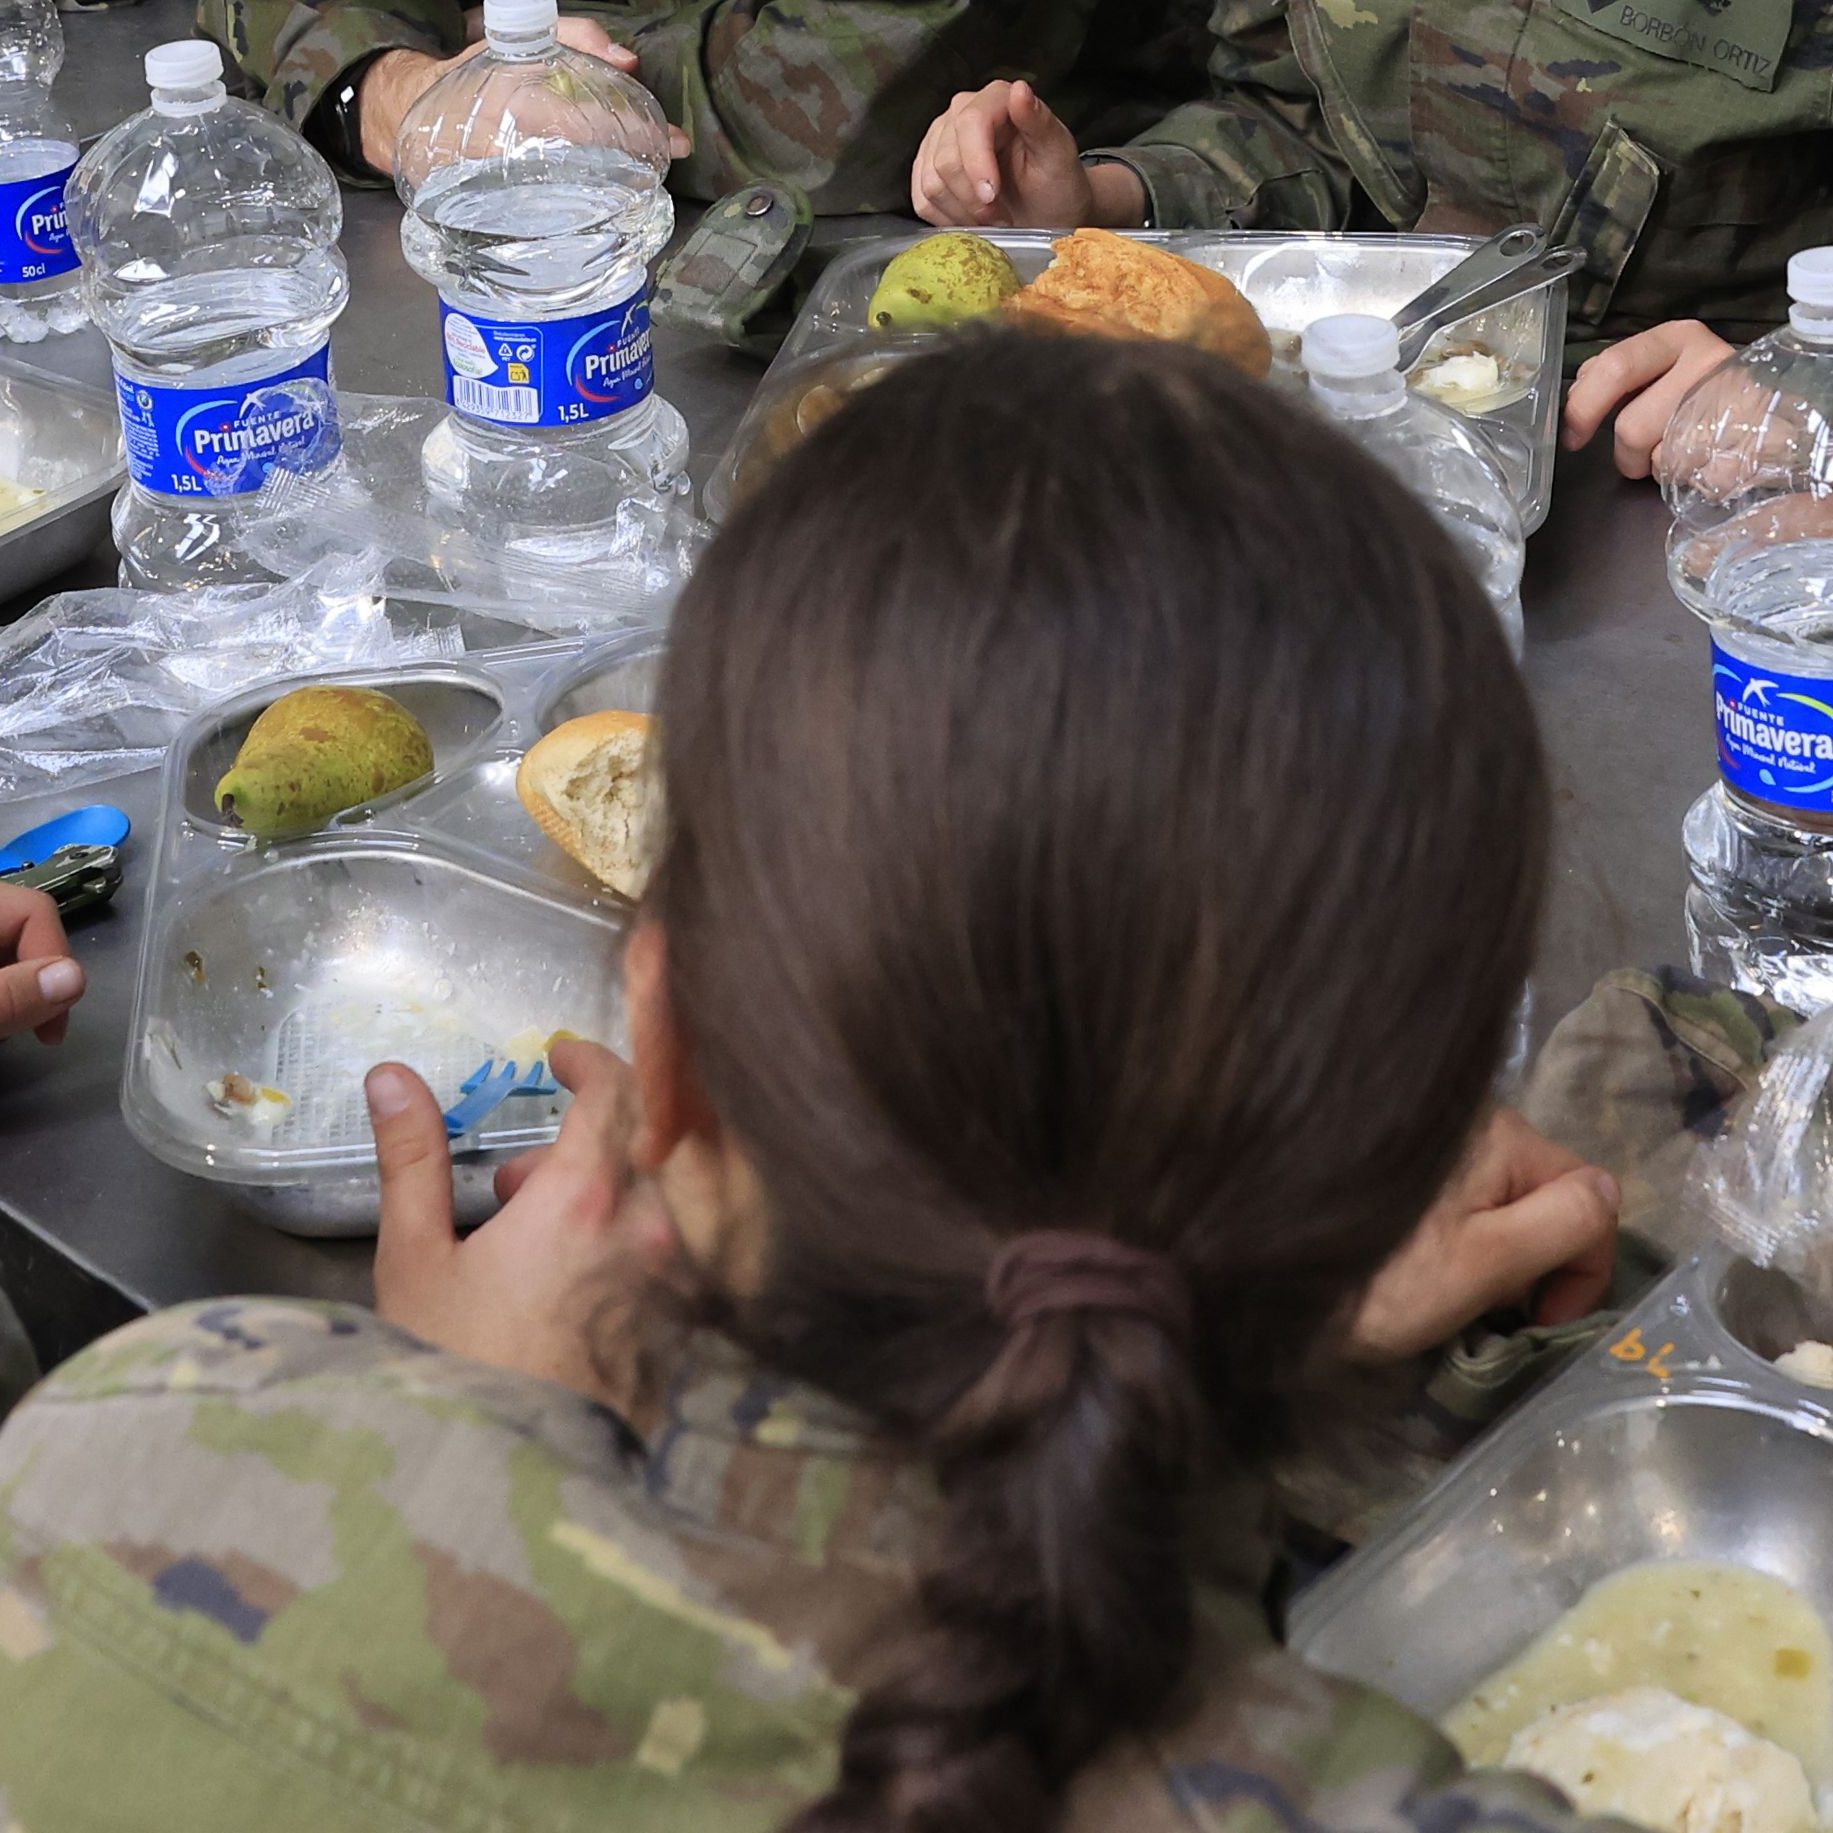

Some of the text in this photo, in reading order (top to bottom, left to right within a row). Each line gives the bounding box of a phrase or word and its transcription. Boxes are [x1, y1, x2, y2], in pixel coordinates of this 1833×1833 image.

[1713, 39, 1772, 73] ORTIZ
[234, 410, 281, 428] FUENTE
[558, 403, 589, 423] 1,5L
[194, 410, 315, 454] Primavera
[172, 474, 202, 492] 1,5L
[1738, 702, 1785, 727] FUENTE
